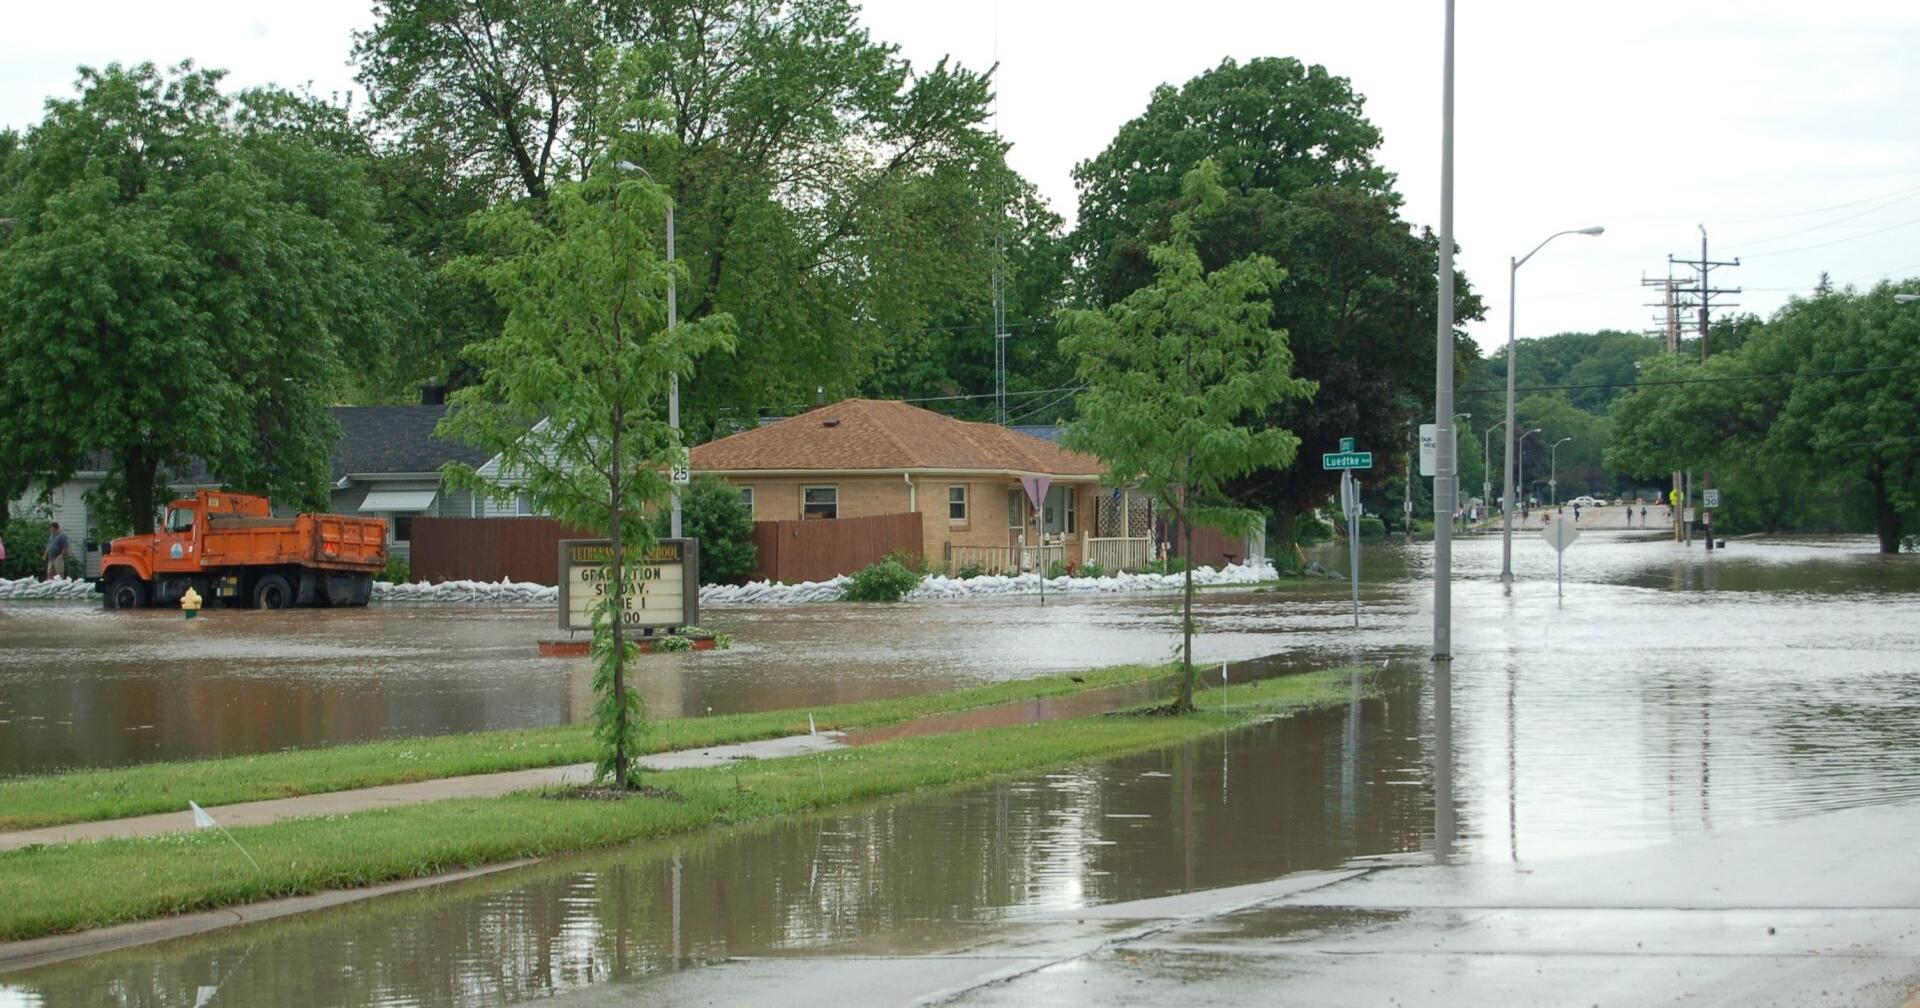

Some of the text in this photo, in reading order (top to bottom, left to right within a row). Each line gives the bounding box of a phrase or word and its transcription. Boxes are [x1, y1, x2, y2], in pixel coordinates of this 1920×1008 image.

[1326, 457, 1360, 467] Luedtke
[674, 468, 687, 480] 25
[581, 567, 661, 581] GRADATION
